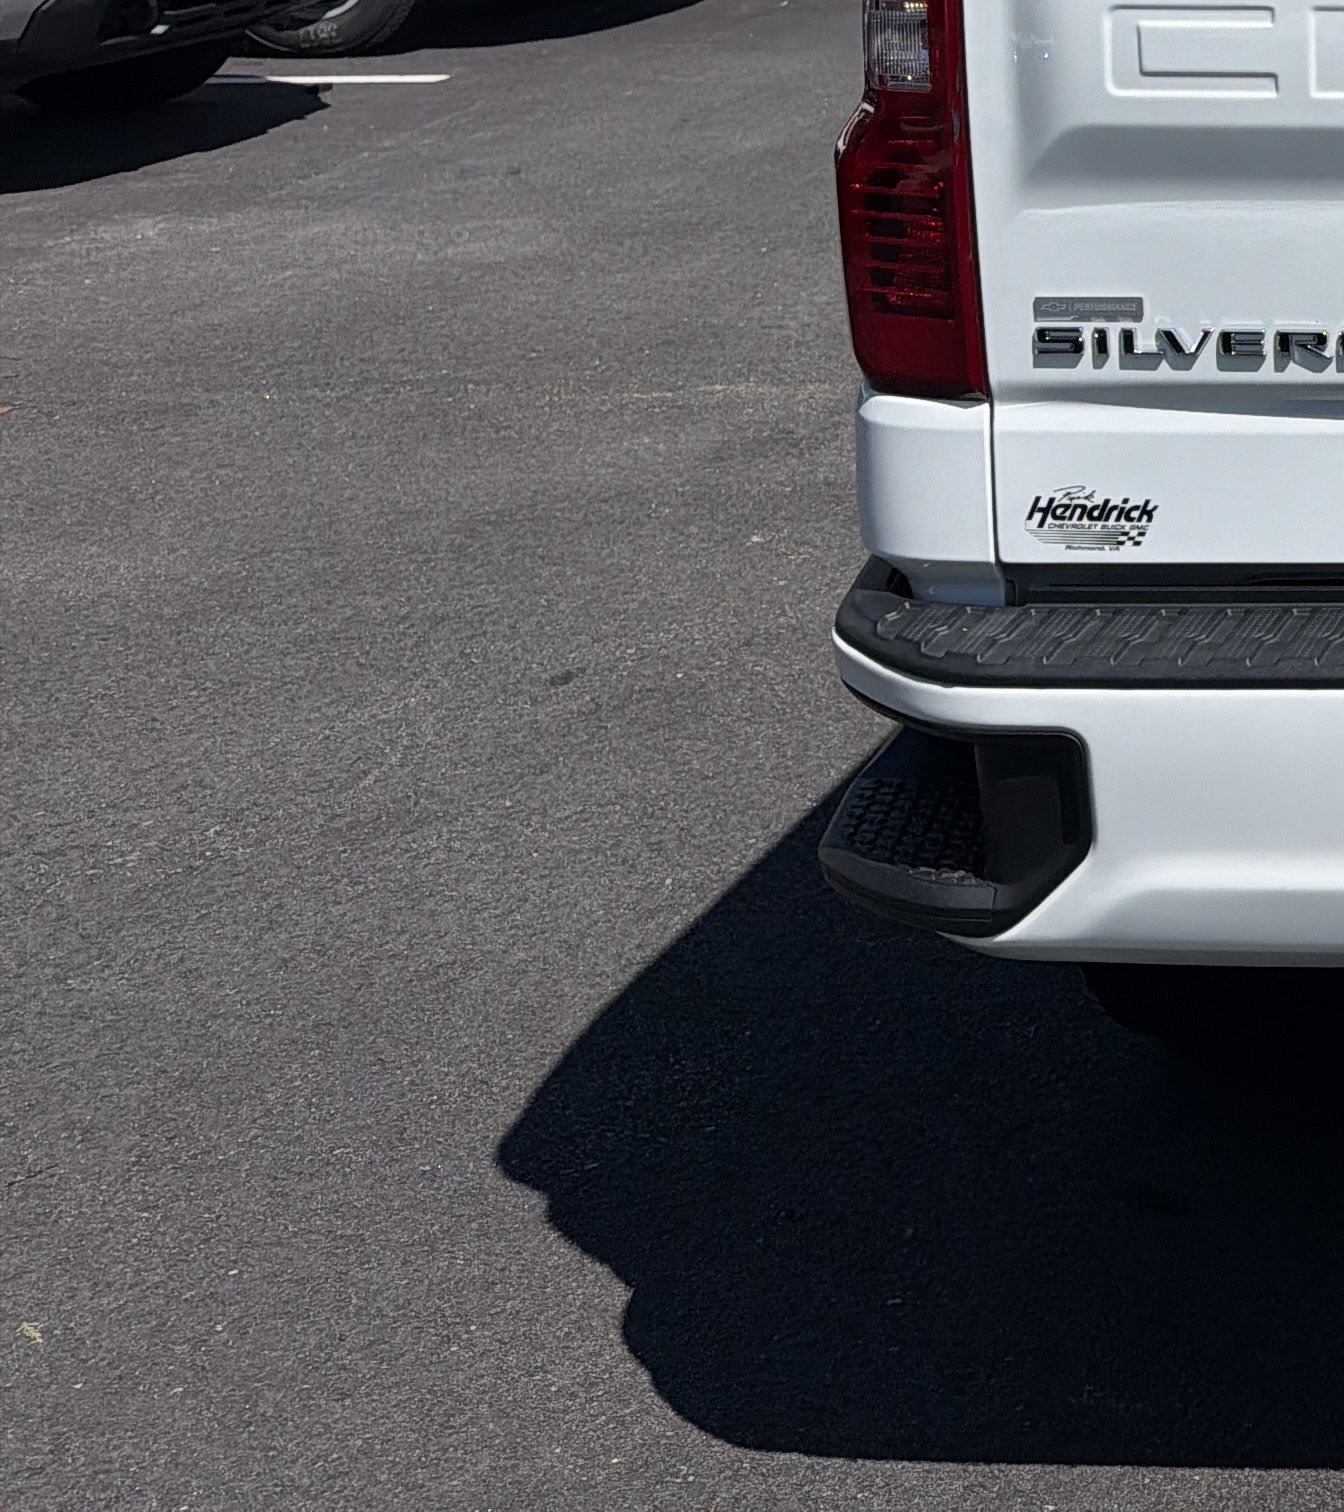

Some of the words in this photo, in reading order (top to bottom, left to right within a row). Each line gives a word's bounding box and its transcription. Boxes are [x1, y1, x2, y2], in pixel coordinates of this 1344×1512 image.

[1026, 496, 1159, 529] Hendrick
[1047, 522, 1098, 530] CHEVROLET
[1100, 523, 1127, 531] BUICK
